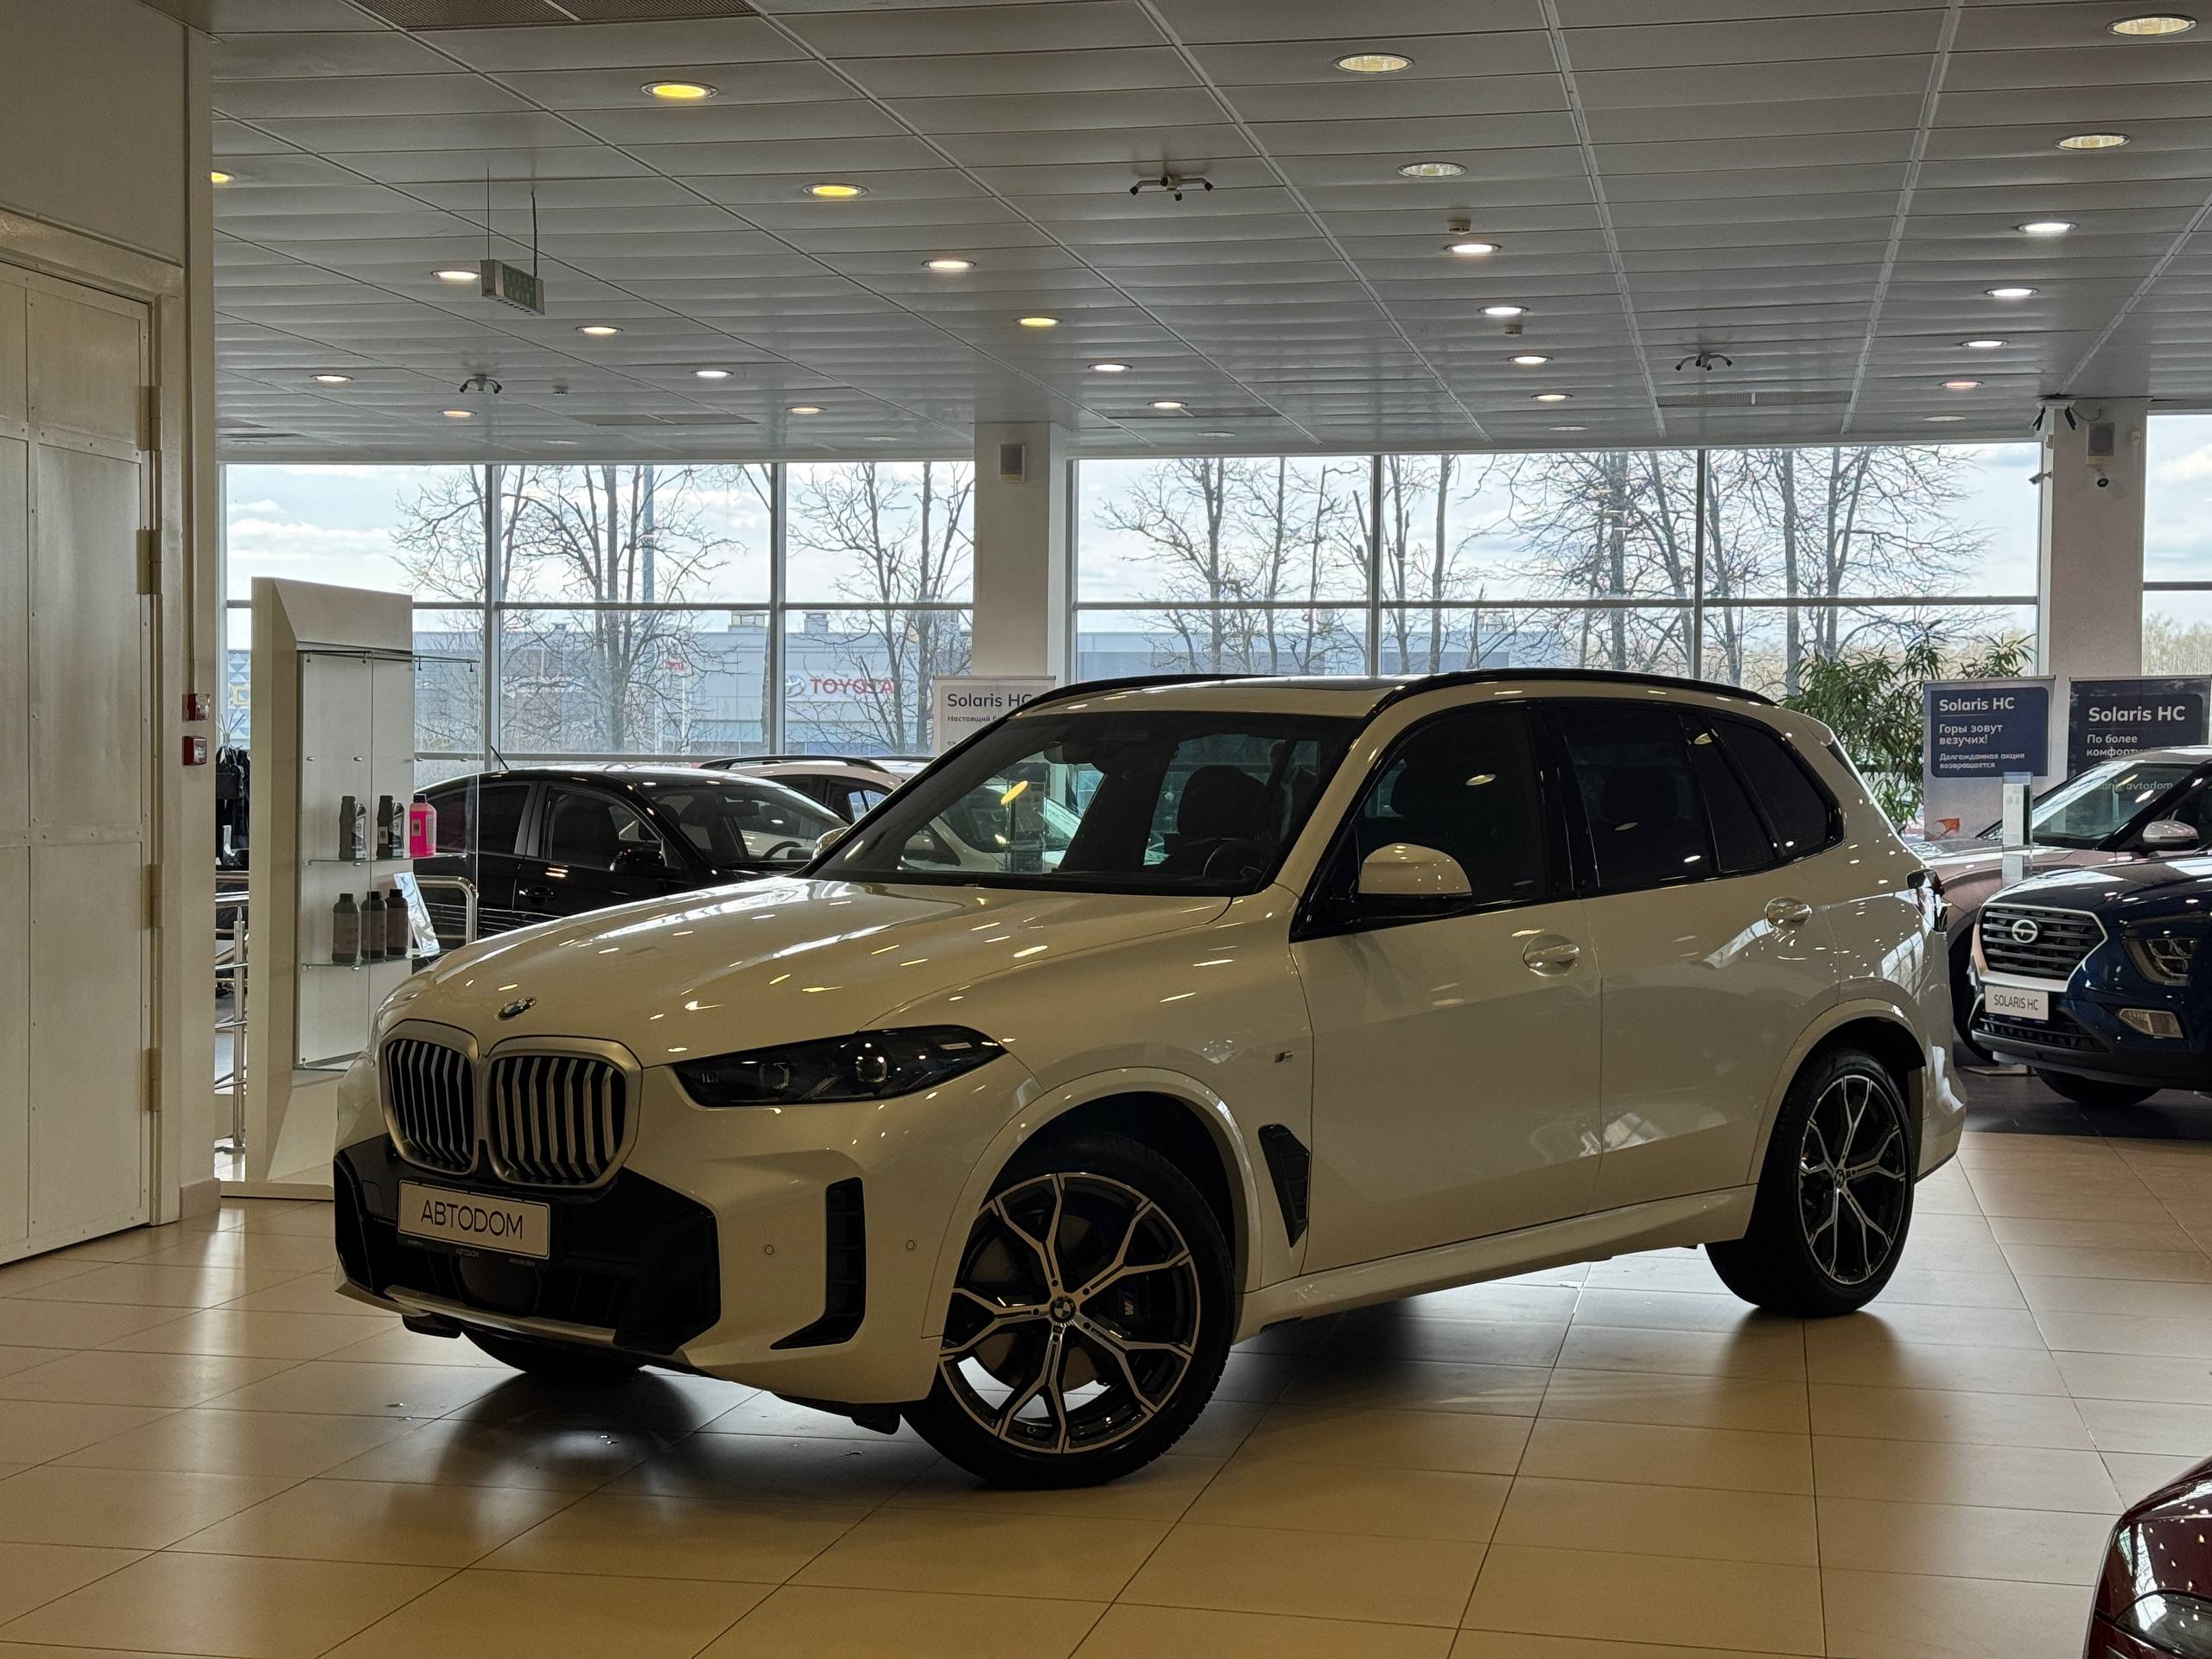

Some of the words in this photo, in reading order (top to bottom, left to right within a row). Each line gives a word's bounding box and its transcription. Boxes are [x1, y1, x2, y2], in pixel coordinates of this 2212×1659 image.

[947, 693, 1002, 707] Solaris
[1008, 694, 1033, 707] HC
[1939, 697, 1988, 711] Solaris
[1993, 696, 2015, 709] HC
[2088, 706, 2152, 721] Solaris
[2158, 705, 2186, 721] HC
[1939, 724, 1967, 734] Горы
[1971, 725, 2003, 734] зовут
[1939, 734, 1987, 747] везучих!
[2087, 734, 2102, 743] По
[2105, 734, 2138, 743] более
[1939, 753, 1999, 762] Долгожданная
[2126, 781, 2173, 790] avtodom
[1993, 994, 2026, 1009] SOLARIS
[2027, 999, 2039, 1011] HC
[420, 1199, 523, 1239] ABTODOM
